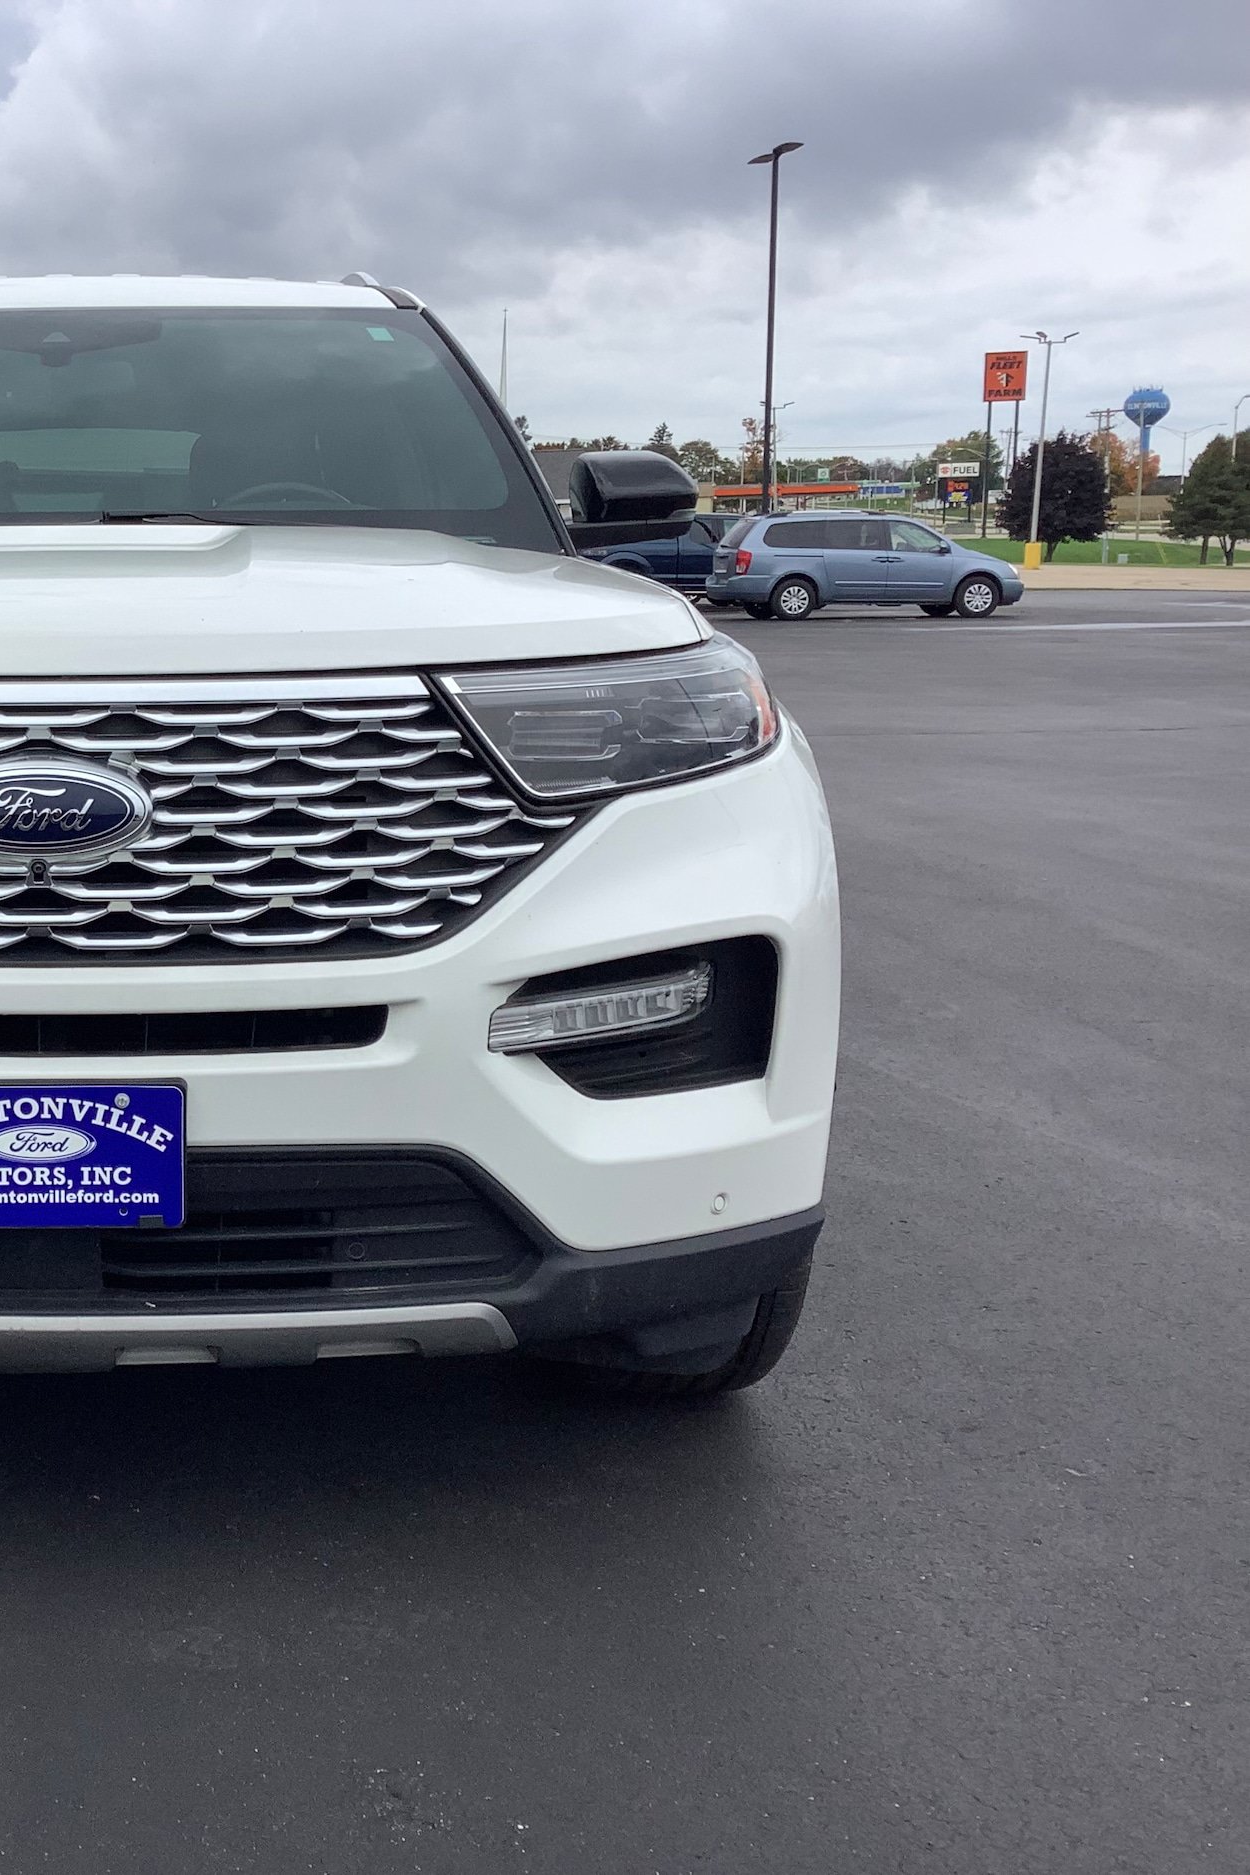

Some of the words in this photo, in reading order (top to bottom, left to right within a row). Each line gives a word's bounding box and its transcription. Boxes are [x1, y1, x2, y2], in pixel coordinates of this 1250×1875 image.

[990, 361, 1022, 370] FLEET
[988, 388, 1022, 398] FARM
[953, 466, 978, 475] FUEL
[9, 1131, 70, 1153] Ford
[80, 1166, 132, 1186] INC
